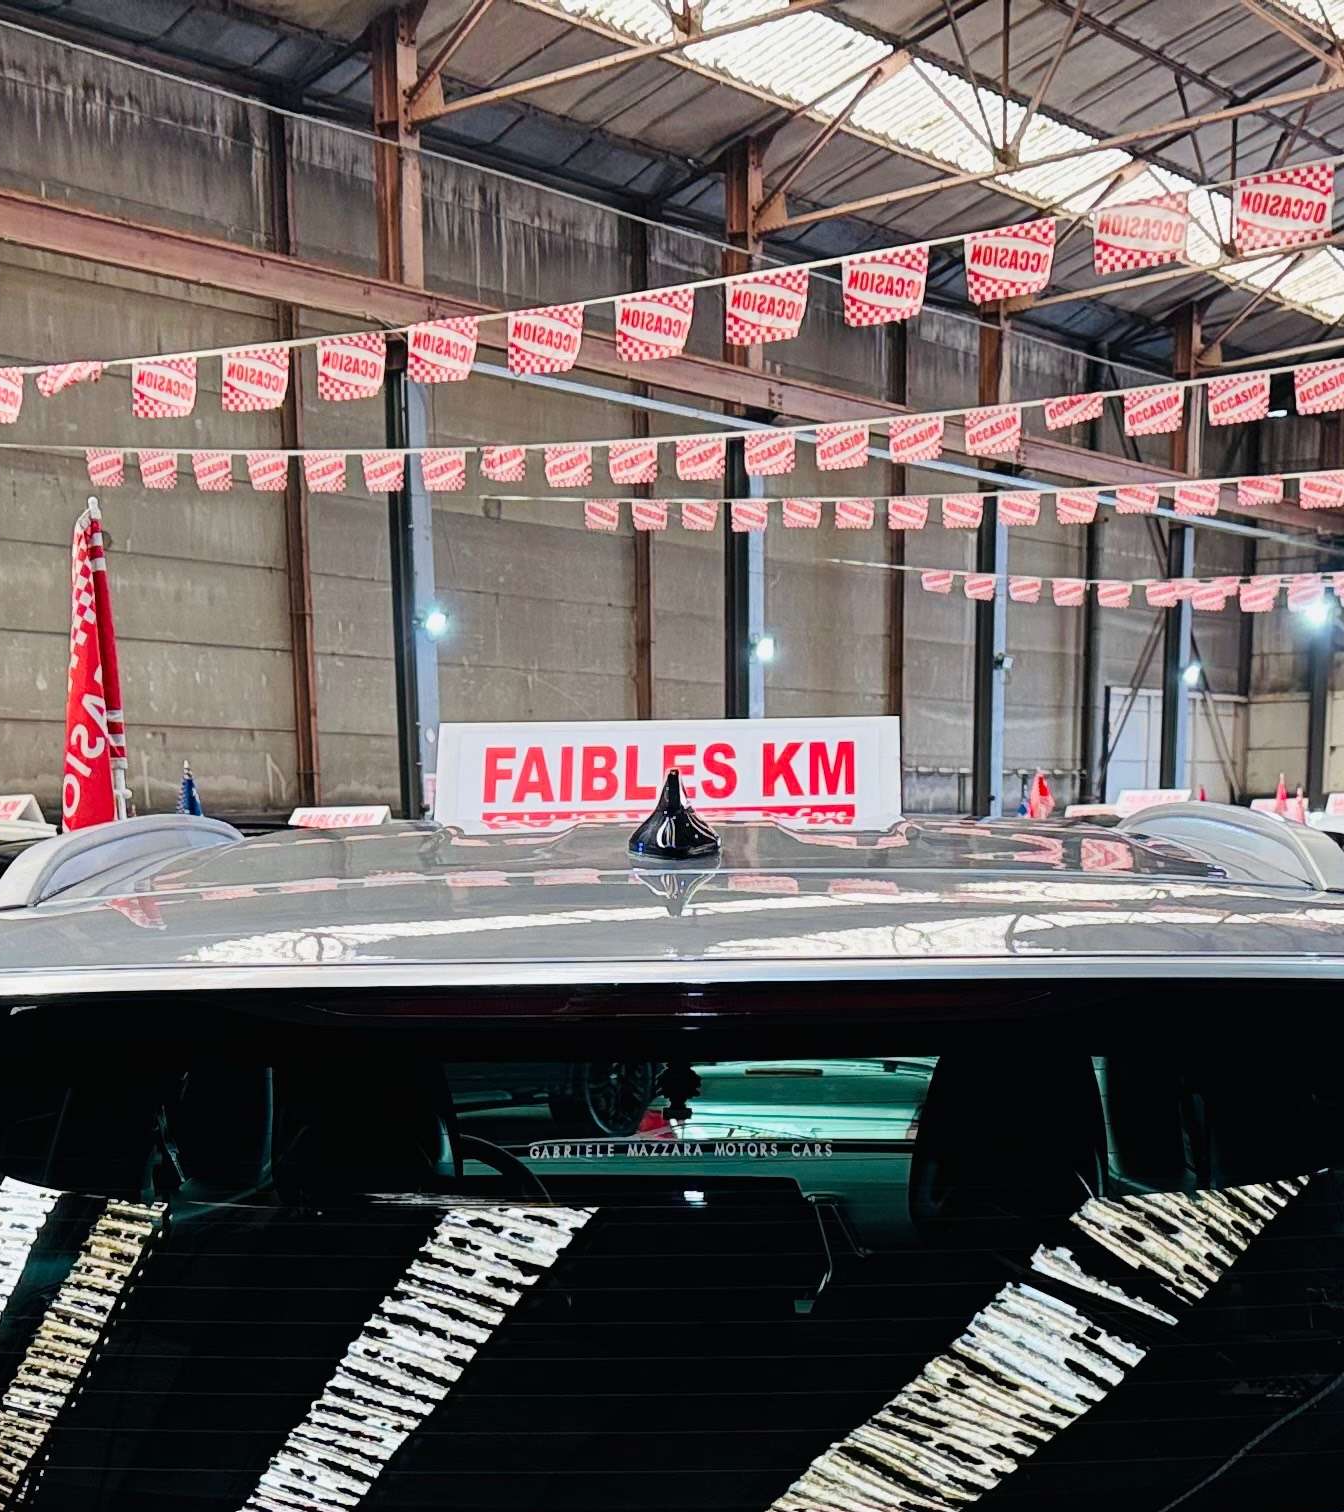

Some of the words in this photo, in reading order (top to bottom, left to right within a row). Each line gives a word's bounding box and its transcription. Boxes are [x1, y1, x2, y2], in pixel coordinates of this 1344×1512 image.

[1129, 394, 1180, 425] OCCASION
[1213, 383, 1265, 414] OCCASION
[969, 416, 1016, 444] OCCASION
[482, 742, 738, 803] FAIBLES
[762, 741, 855, 797] KM
[529, 1144, 615, 1160] GABRIELE
[627, 1143, 703, 1158] MAZZARA
[714, 1143, 779, 1158] MOTORS
[791, 1143, 834, 1158] CARS
